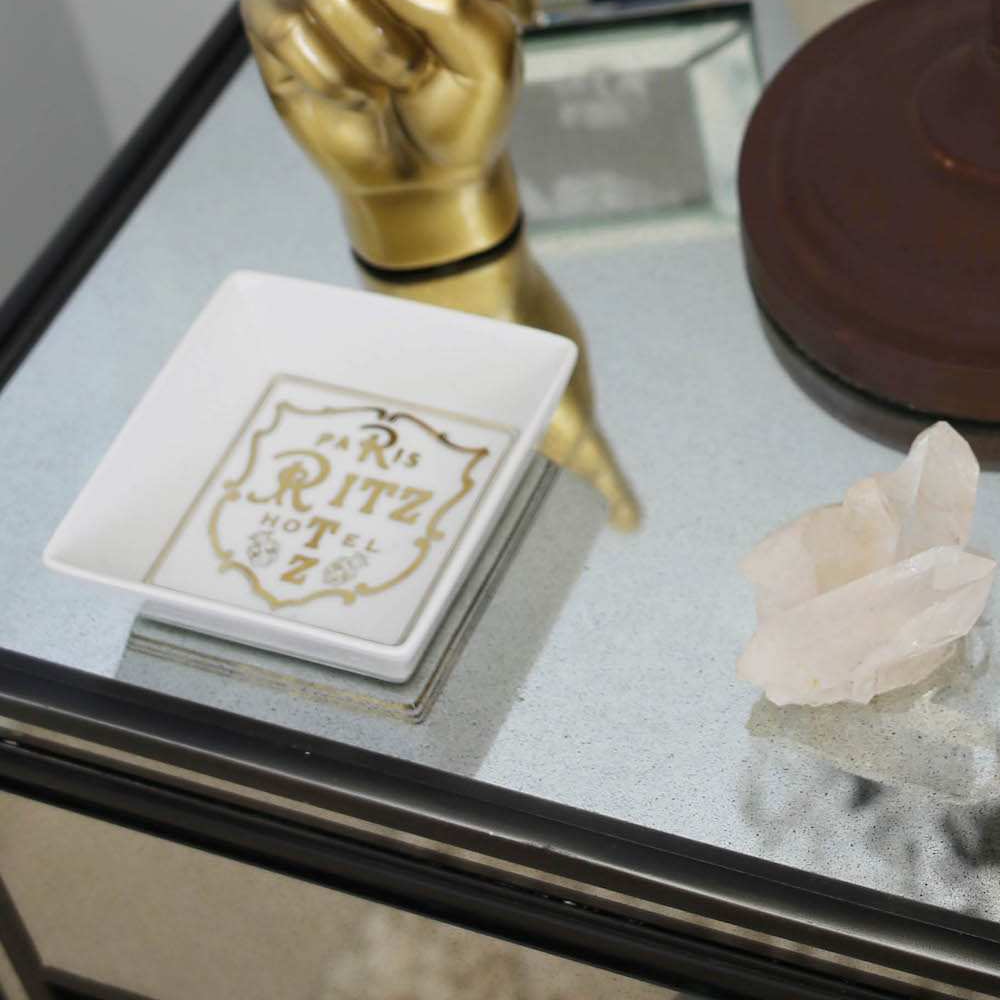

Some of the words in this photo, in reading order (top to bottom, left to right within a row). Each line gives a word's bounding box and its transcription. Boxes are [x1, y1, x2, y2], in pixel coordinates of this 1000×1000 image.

[314, 424, 422, 470] PARIS
[247, 449, 434, 525] RITZ
[259, 513, 381, 553] HOTEL
[281, 554, 319, 584] Z
